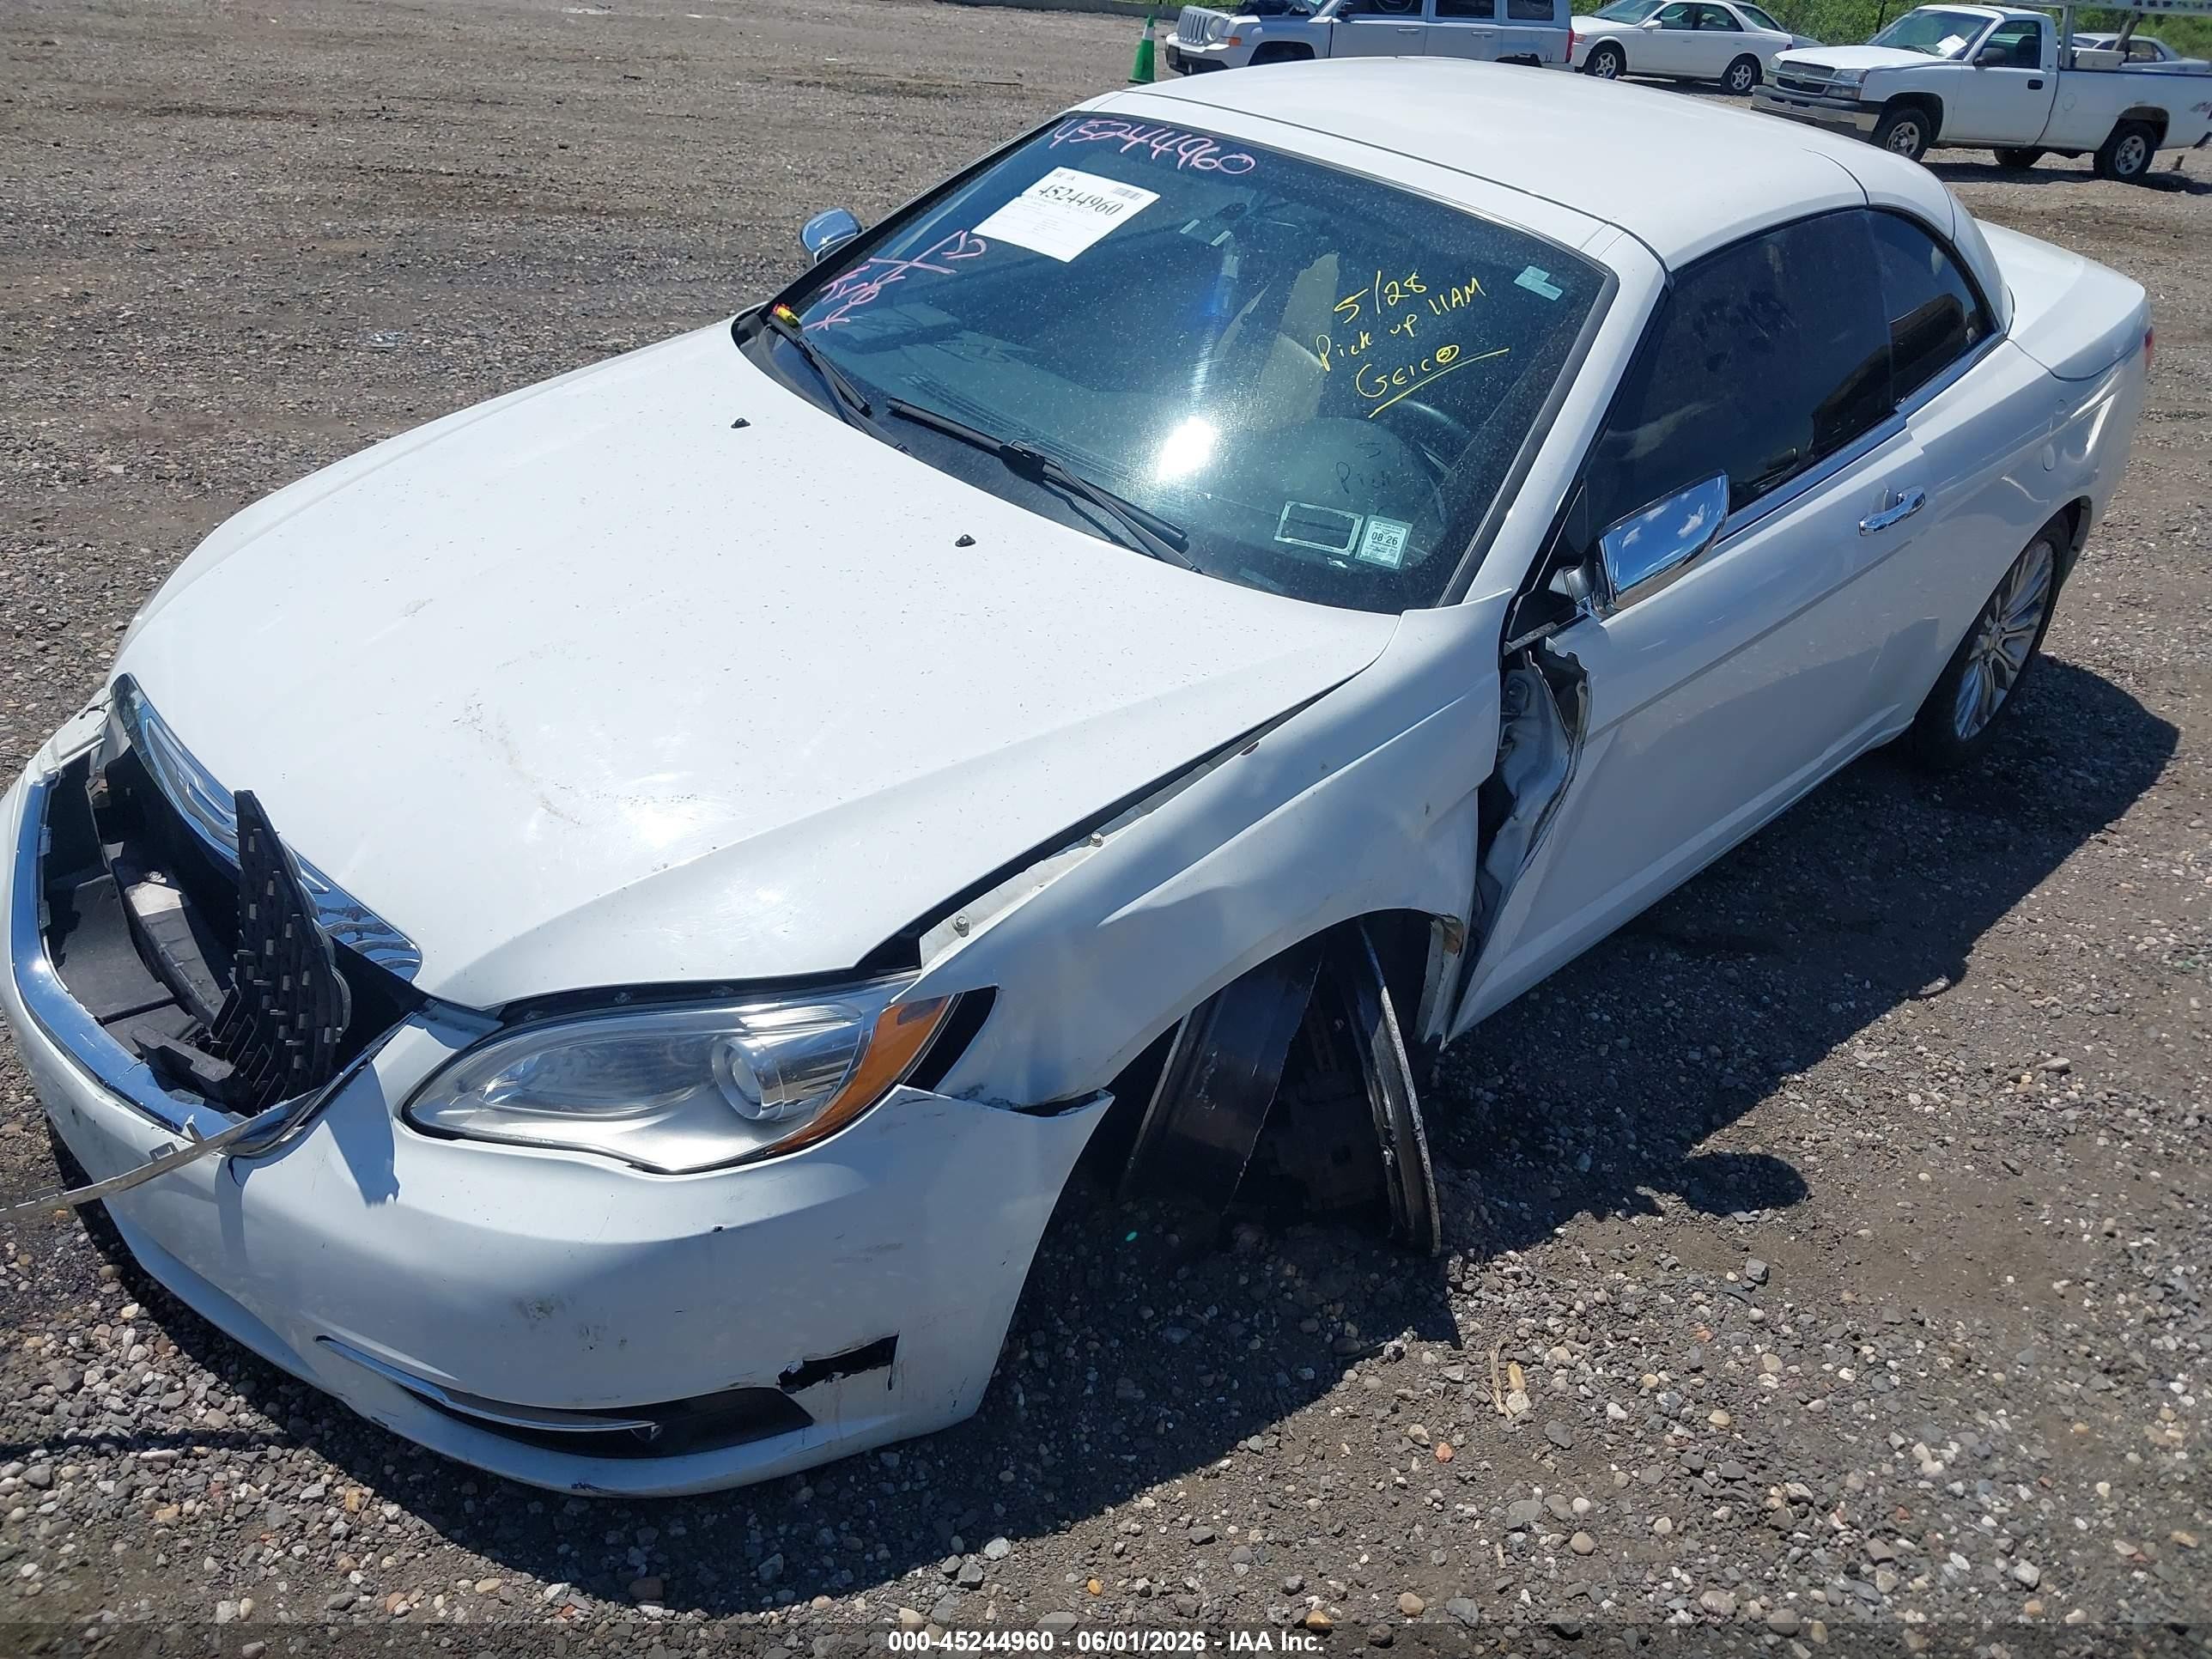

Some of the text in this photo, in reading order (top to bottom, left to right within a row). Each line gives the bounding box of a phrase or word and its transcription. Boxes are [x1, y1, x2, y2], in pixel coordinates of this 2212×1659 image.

[1048, 118, 1256, 174] 45244960
[1037, 184, 1124, 216] 45244960
[1334, 270, 1427, 324] 5/28
[1429, 277, 1486, 315] 11AM
